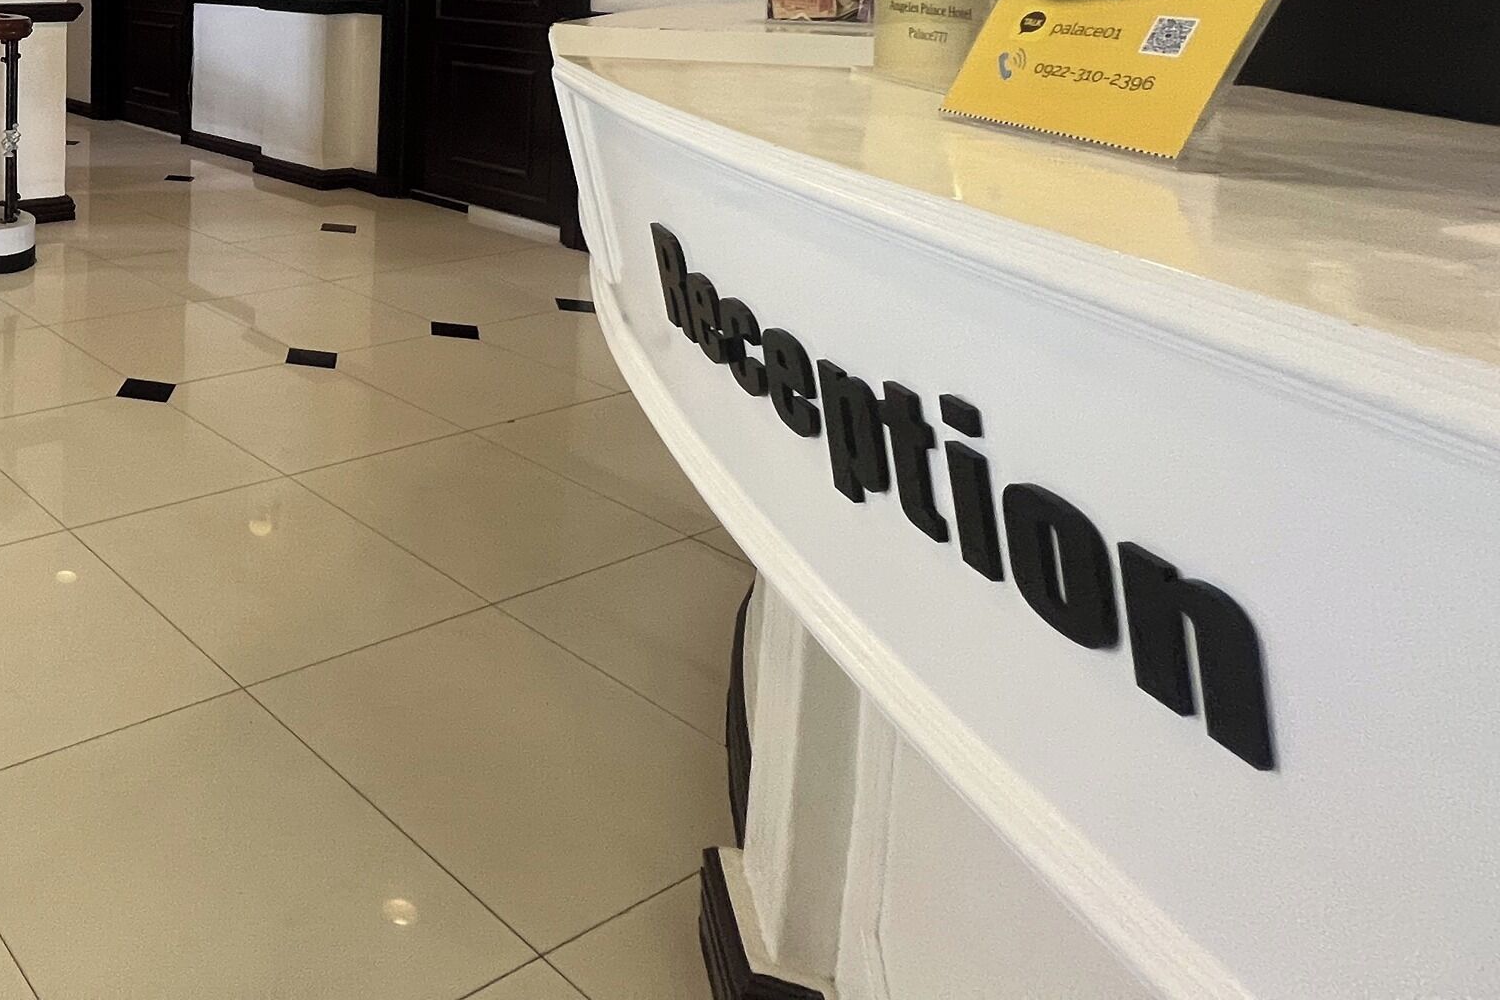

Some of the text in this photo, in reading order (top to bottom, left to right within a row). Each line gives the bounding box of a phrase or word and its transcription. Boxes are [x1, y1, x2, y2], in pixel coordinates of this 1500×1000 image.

[889, 0, 973, 20] Angeles Palace Hotel
[908, 27, 949, 43] Palace777
[1049, 22, 1123, 40] palace01
[1033, 62, 1157, 91] 0922-310-2396
[650, 222, 1276, 772] Reception
